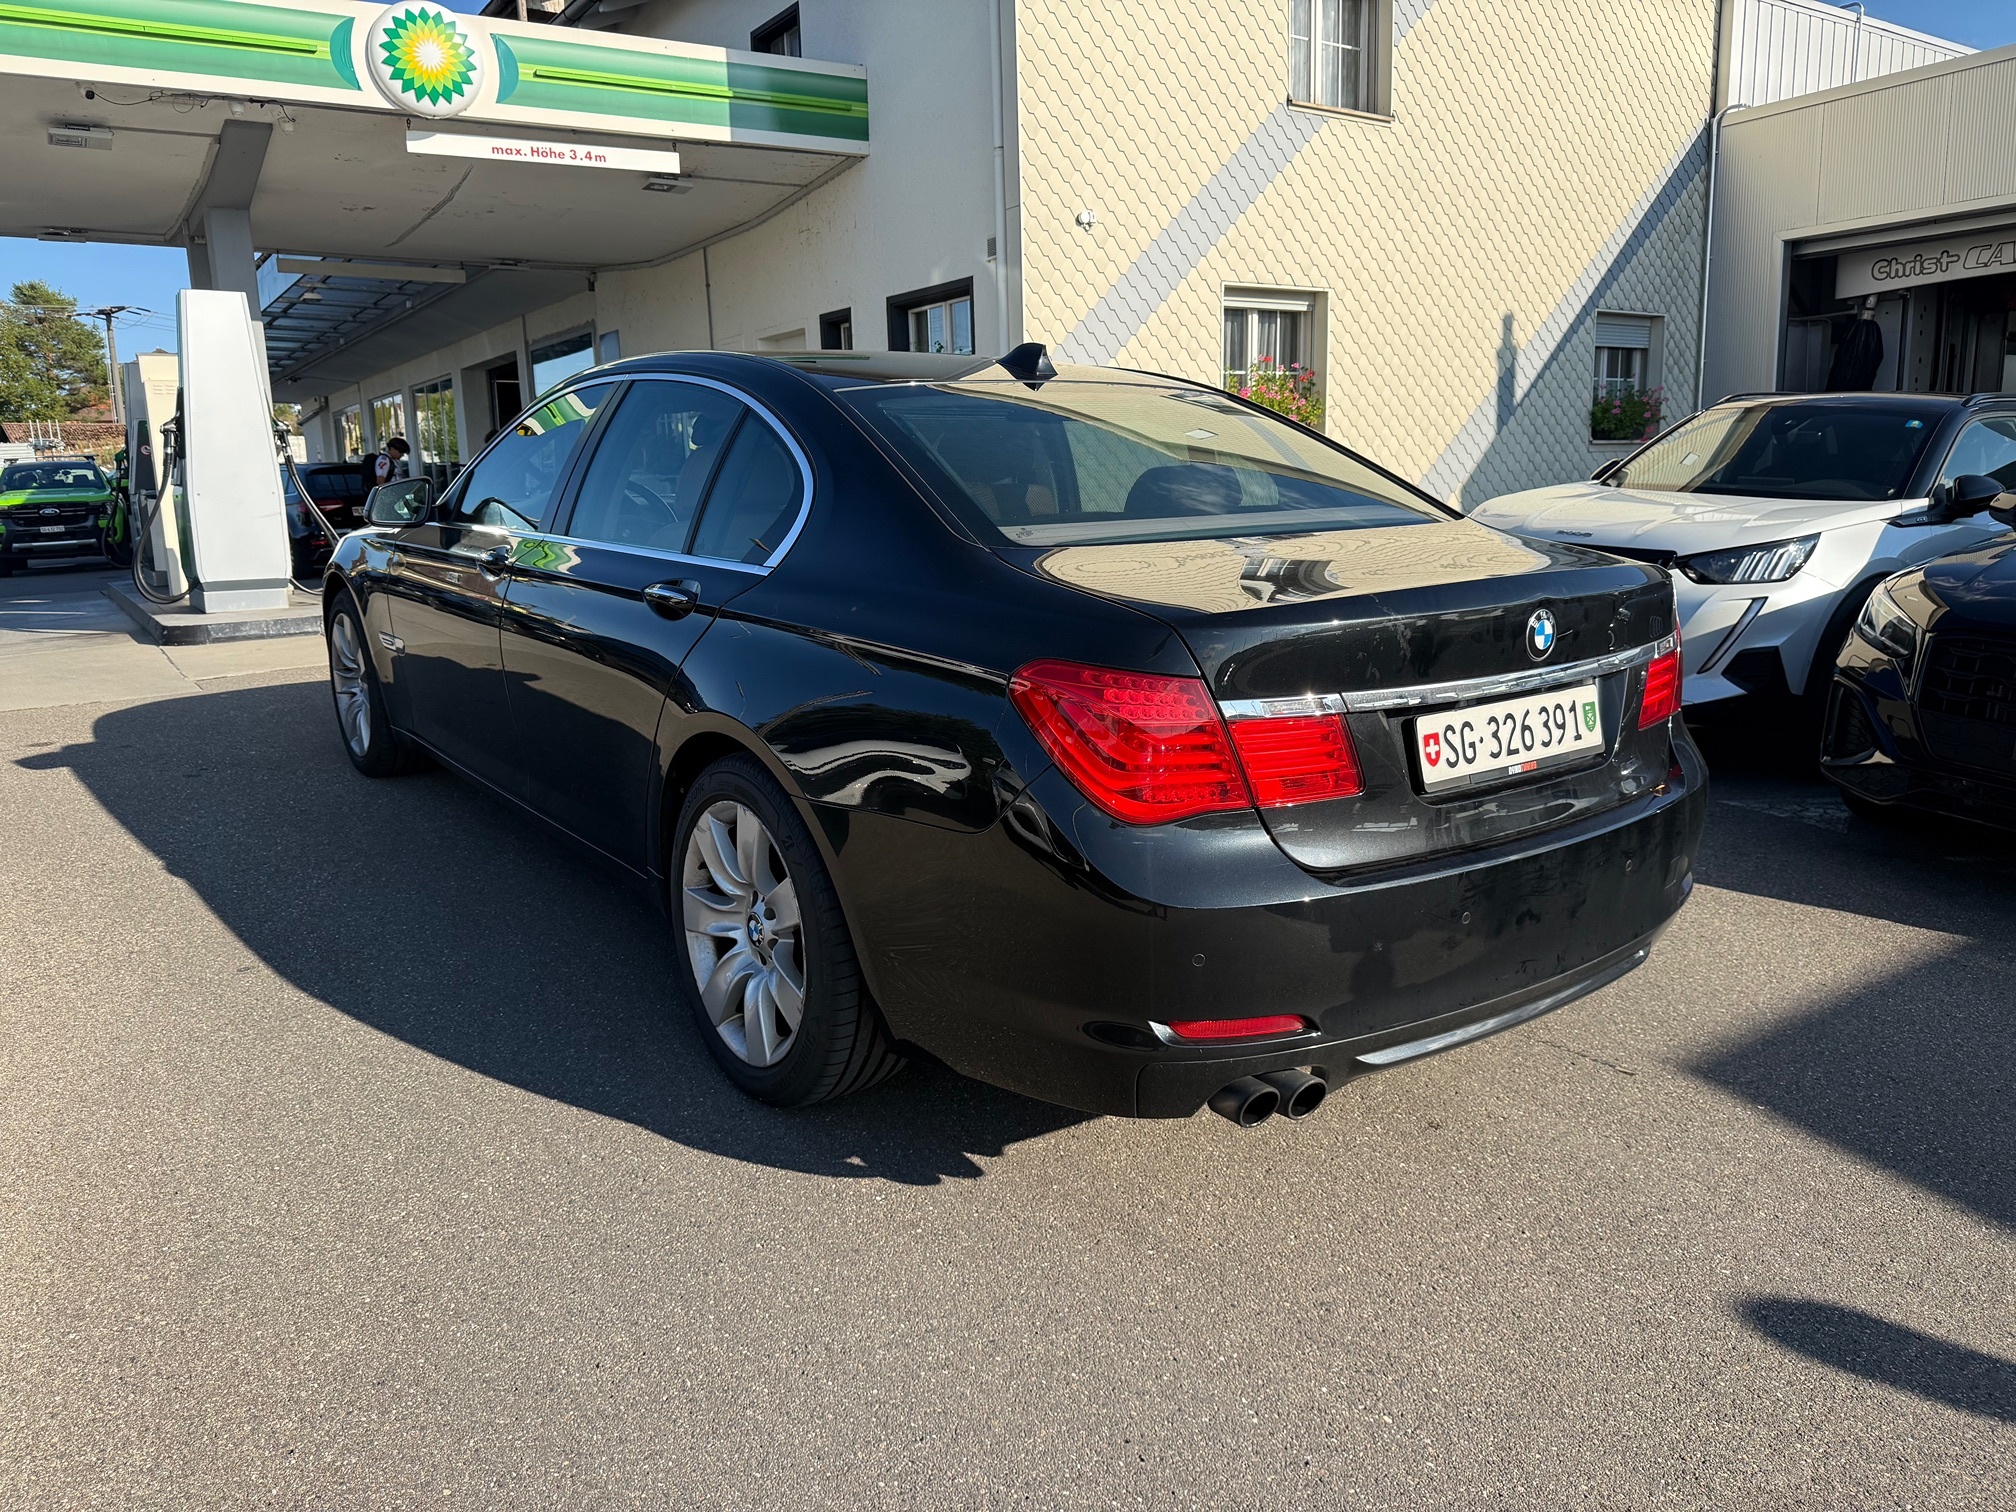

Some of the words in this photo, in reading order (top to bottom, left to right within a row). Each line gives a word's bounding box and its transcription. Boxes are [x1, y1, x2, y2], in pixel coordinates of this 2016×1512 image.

[491, 146, 528, 157] max.
[530, 146, 566, 160] Höhe
[1871, 250, 1960, 281] Christ
